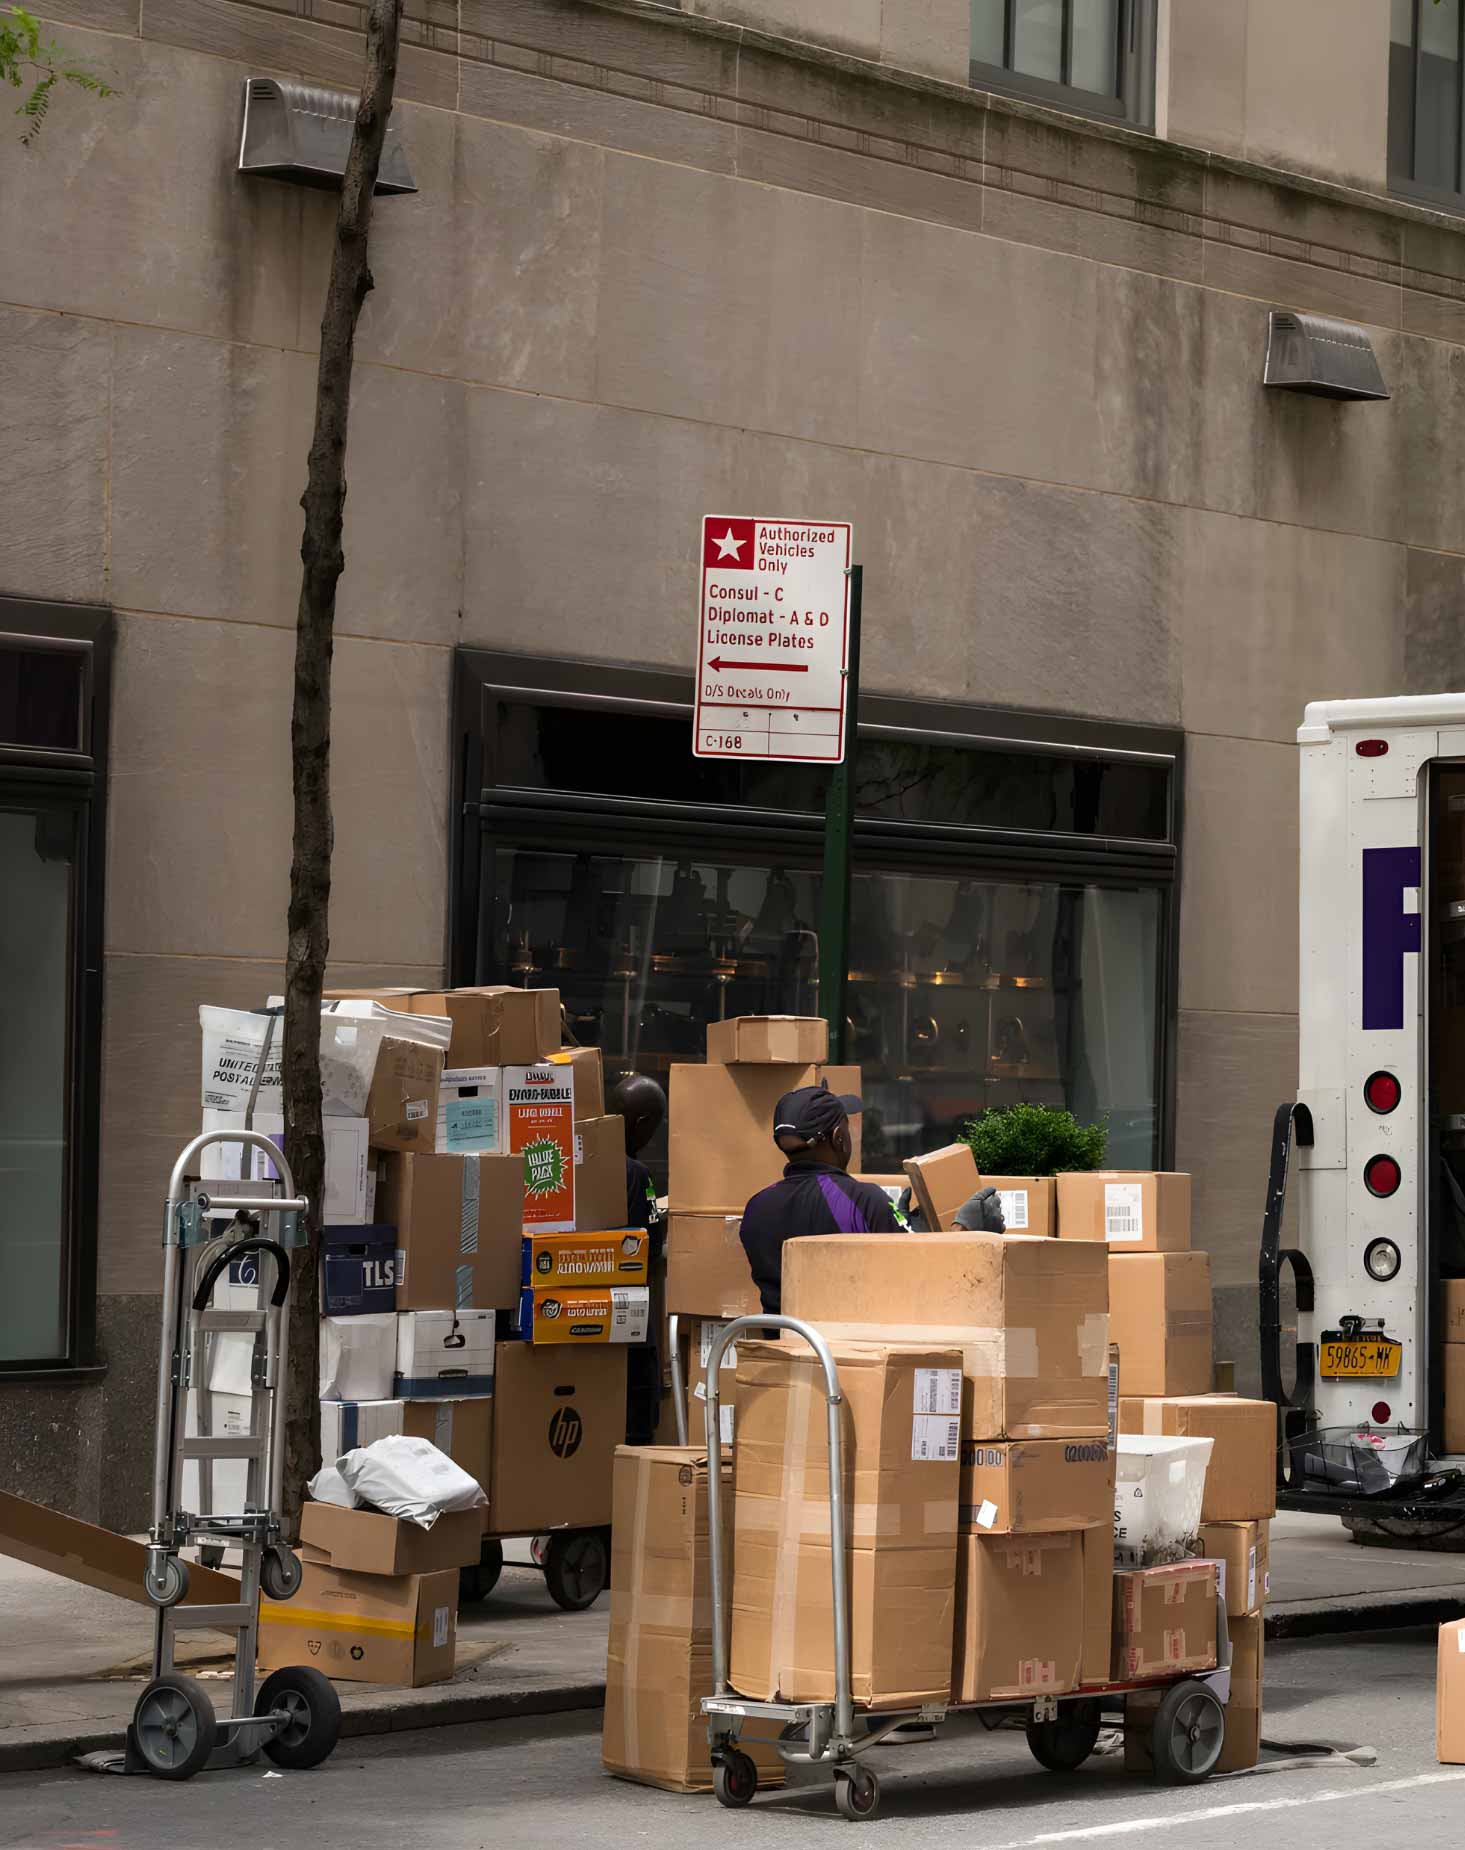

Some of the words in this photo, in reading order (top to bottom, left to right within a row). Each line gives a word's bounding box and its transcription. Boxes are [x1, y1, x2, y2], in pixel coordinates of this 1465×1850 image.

[760, 527, 835, 543] Authorized
[759, 542, 815, 558] Vehicles
[758, 558, 788, 575] Only
[709, 584, 758, 600] Consul
[774, 587, 784, 601] C
[708, 606, 774, 624] Diplomat
[789, 610, 799, 625] A
[804, 611, 814, 626] &
[819, 612, 829, 627] D
[707, 629, 763, 646] License
[768, 632, 814, 649] Plates
[727, 685, 763, 699] Decals
[766, 687, 791, 702] Only
[362, 1260, 394, 1288] TLS
[551, 1407, 580, 1459] hp
